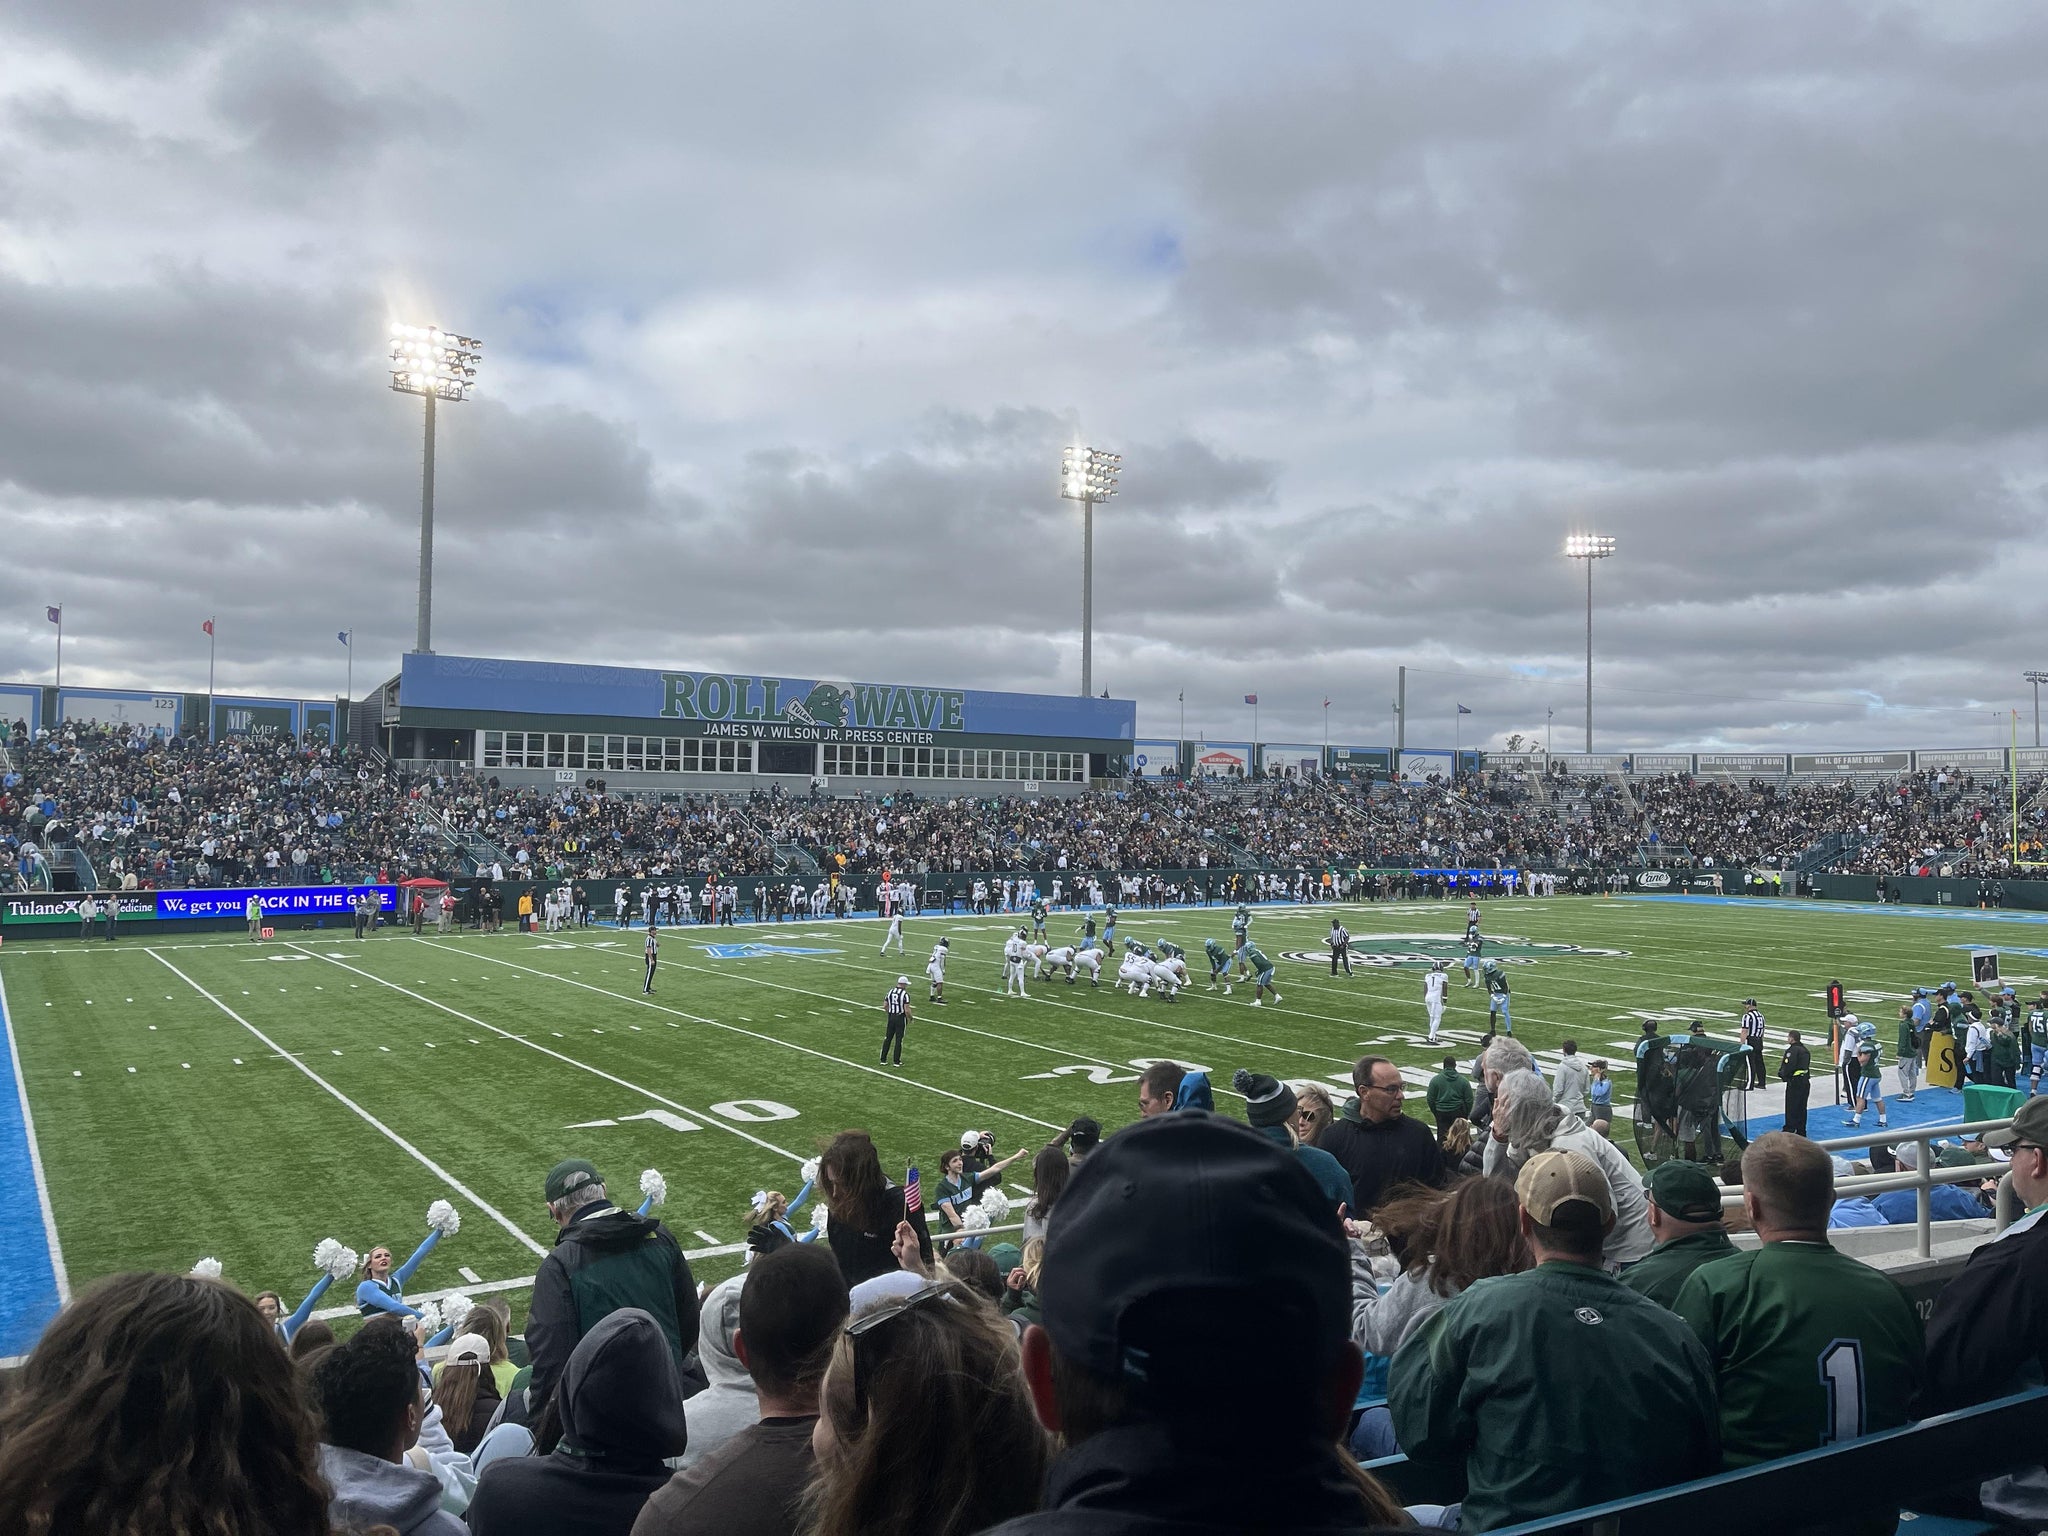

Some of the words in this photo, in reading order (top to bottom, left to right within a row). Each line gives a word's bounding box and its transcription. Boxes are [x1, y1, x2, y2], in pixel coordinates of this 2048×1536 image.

[154, 700, 174, 709] 123
[660, 672, 790, 724] ROLL
[854, 684, 965, 732] WAVE
[703, 723, 748, 737] JAMES
[751, 726, 767, 738] W.
[771, 727, 820, 740] WILSON
[823, 729, 842, 741] JR.
[845, 730, 884, 742] PRESS
[887, 732, 933, 744] CENTER
[1716, 757, 1761, 765] BLUEBONNET
[1763, 757, 1783, 765] BOWL
[1815, 757, 1832, 765] HALL
[1843, 756, 1862, 764] FAME
[559, 772, 574, 780] 122
[8, 901, 64, 916] Tulane
[118, 903, 153, 913] edicine
[163, 899, 187, 911] We
[190, 899, 212, 915] get
[216, 901, 241, 915] you
[294, 896, 309, 908] IN
[314, 895, 342, 907] THE
[347, 893, 392, 905] GAE.
[263, 929, 273, 937] 10
[1126, 953, 1137, 964] 55
[892, 993, 899, 1004] R
[2030, 1016, 2045, 1033] 75
[1939, 1047, 1955, 1073] S
[617, 1100, 801, 1132] 10
[1817, 1337, 1867, 1446] 1
